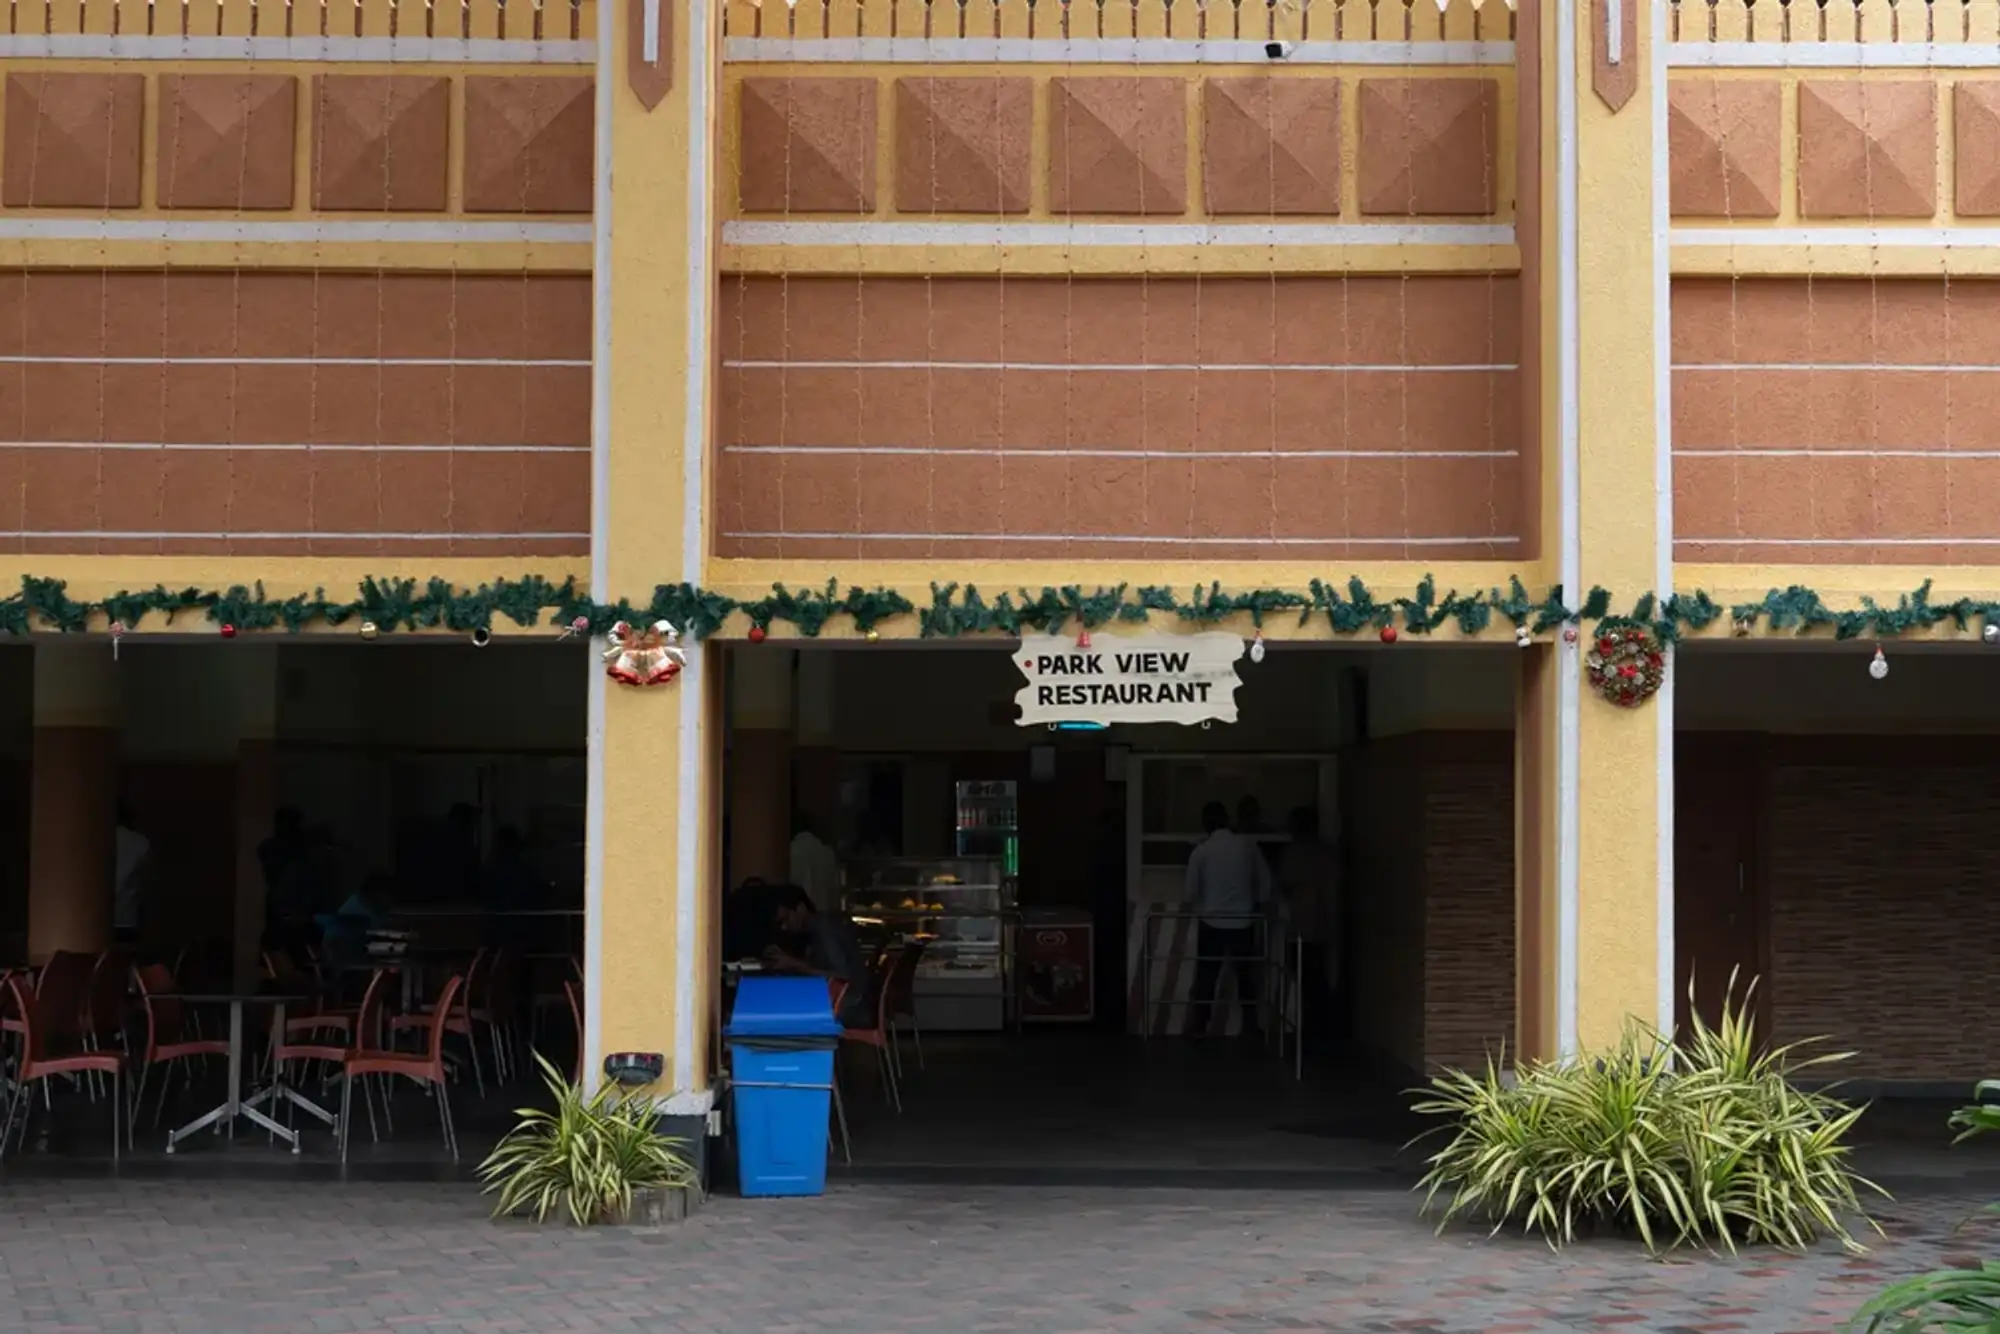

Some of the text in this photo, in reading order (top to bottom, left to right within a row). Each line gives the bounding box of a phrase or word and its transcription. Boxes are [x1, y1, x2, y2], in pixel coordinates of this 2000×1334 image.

[1038, 652, 1190, 675] PARK VIEW
[1038, 682, 1212, 705] RESTAURANT
